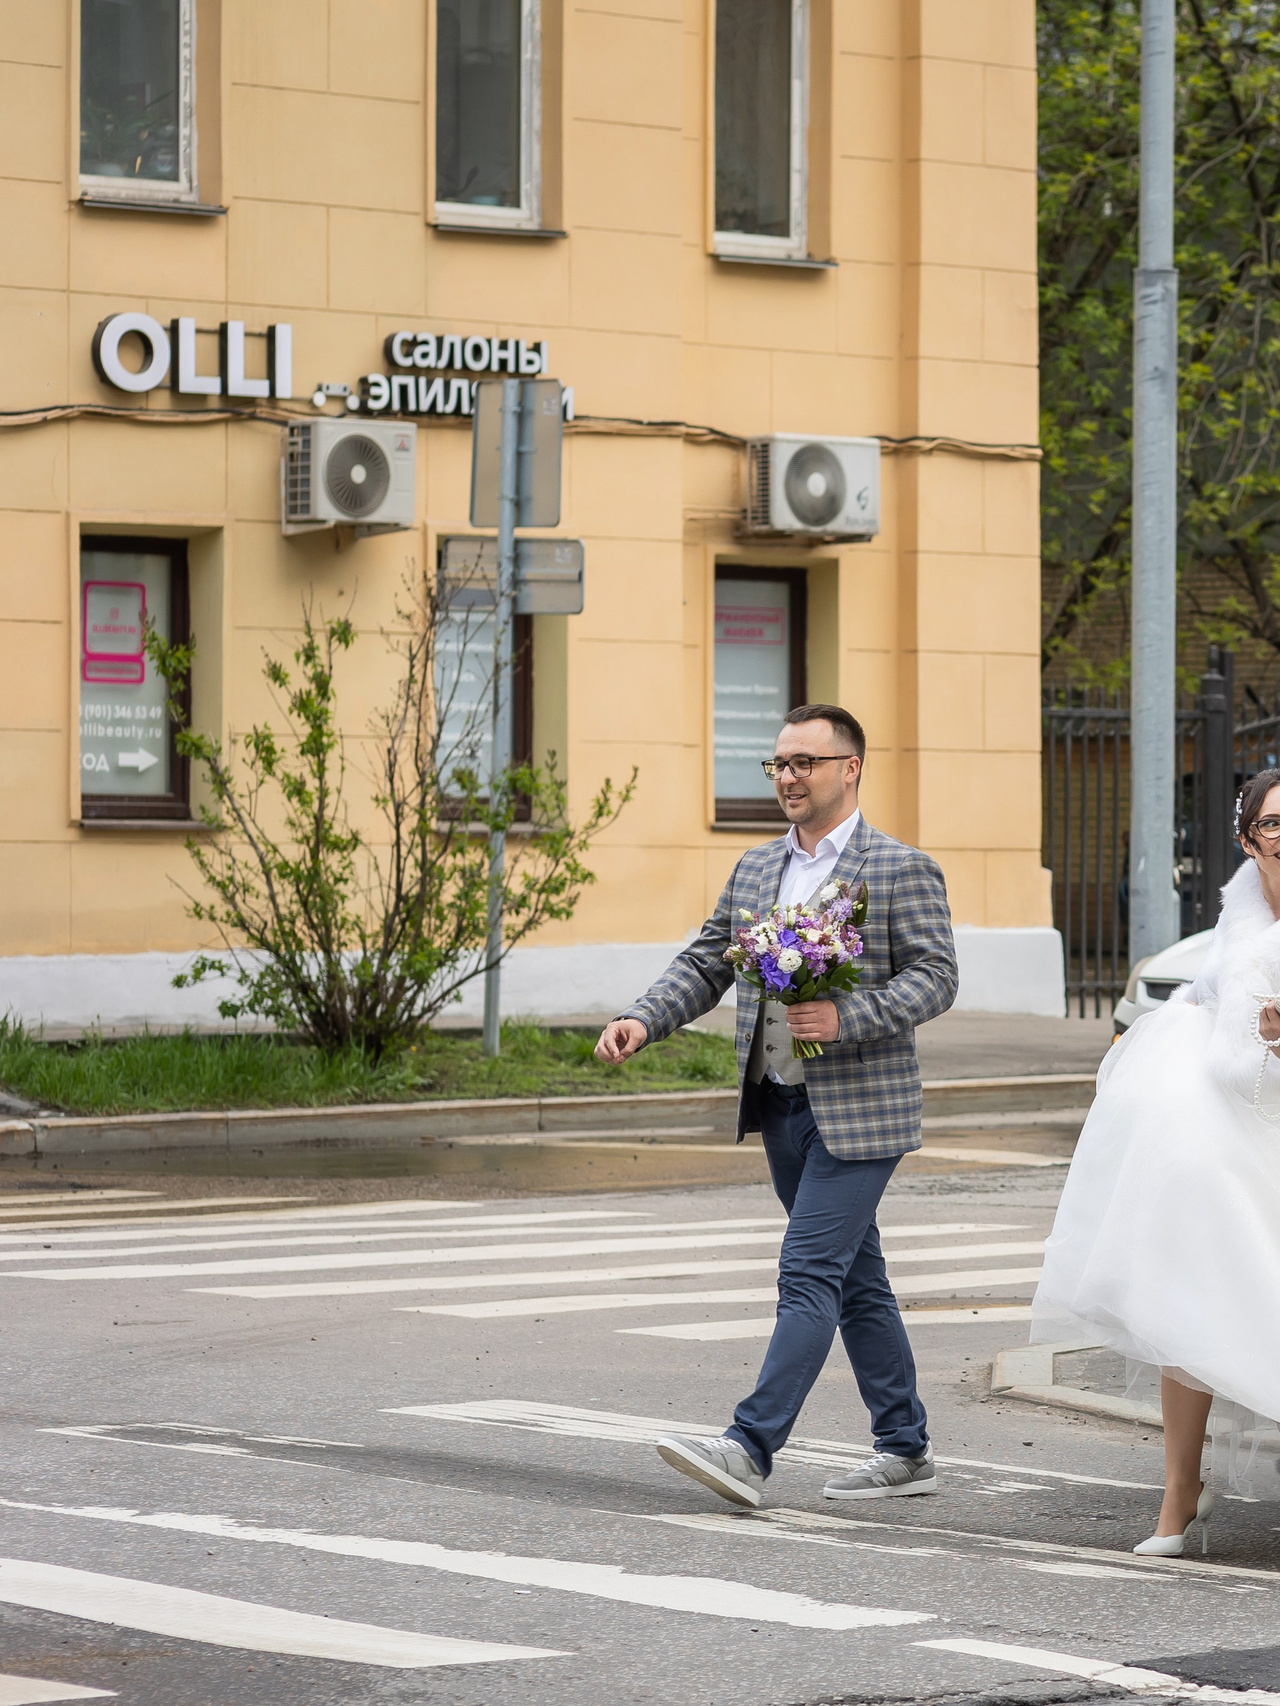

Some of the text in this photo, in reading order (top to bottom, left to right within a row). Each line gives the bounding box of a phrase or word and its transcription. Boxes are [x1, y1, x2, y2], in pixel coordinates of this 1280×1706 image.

[93, 312, 292, 399] OLLI
[387, 330, 549, 375] салоны
[84, 703, 112, 722] (901)
[113, 705, 132, 719] 346
[134, 705, 148, 720] 53
[149, 706, 163, 720] 49
[79, 752, 110, 773] ОД
